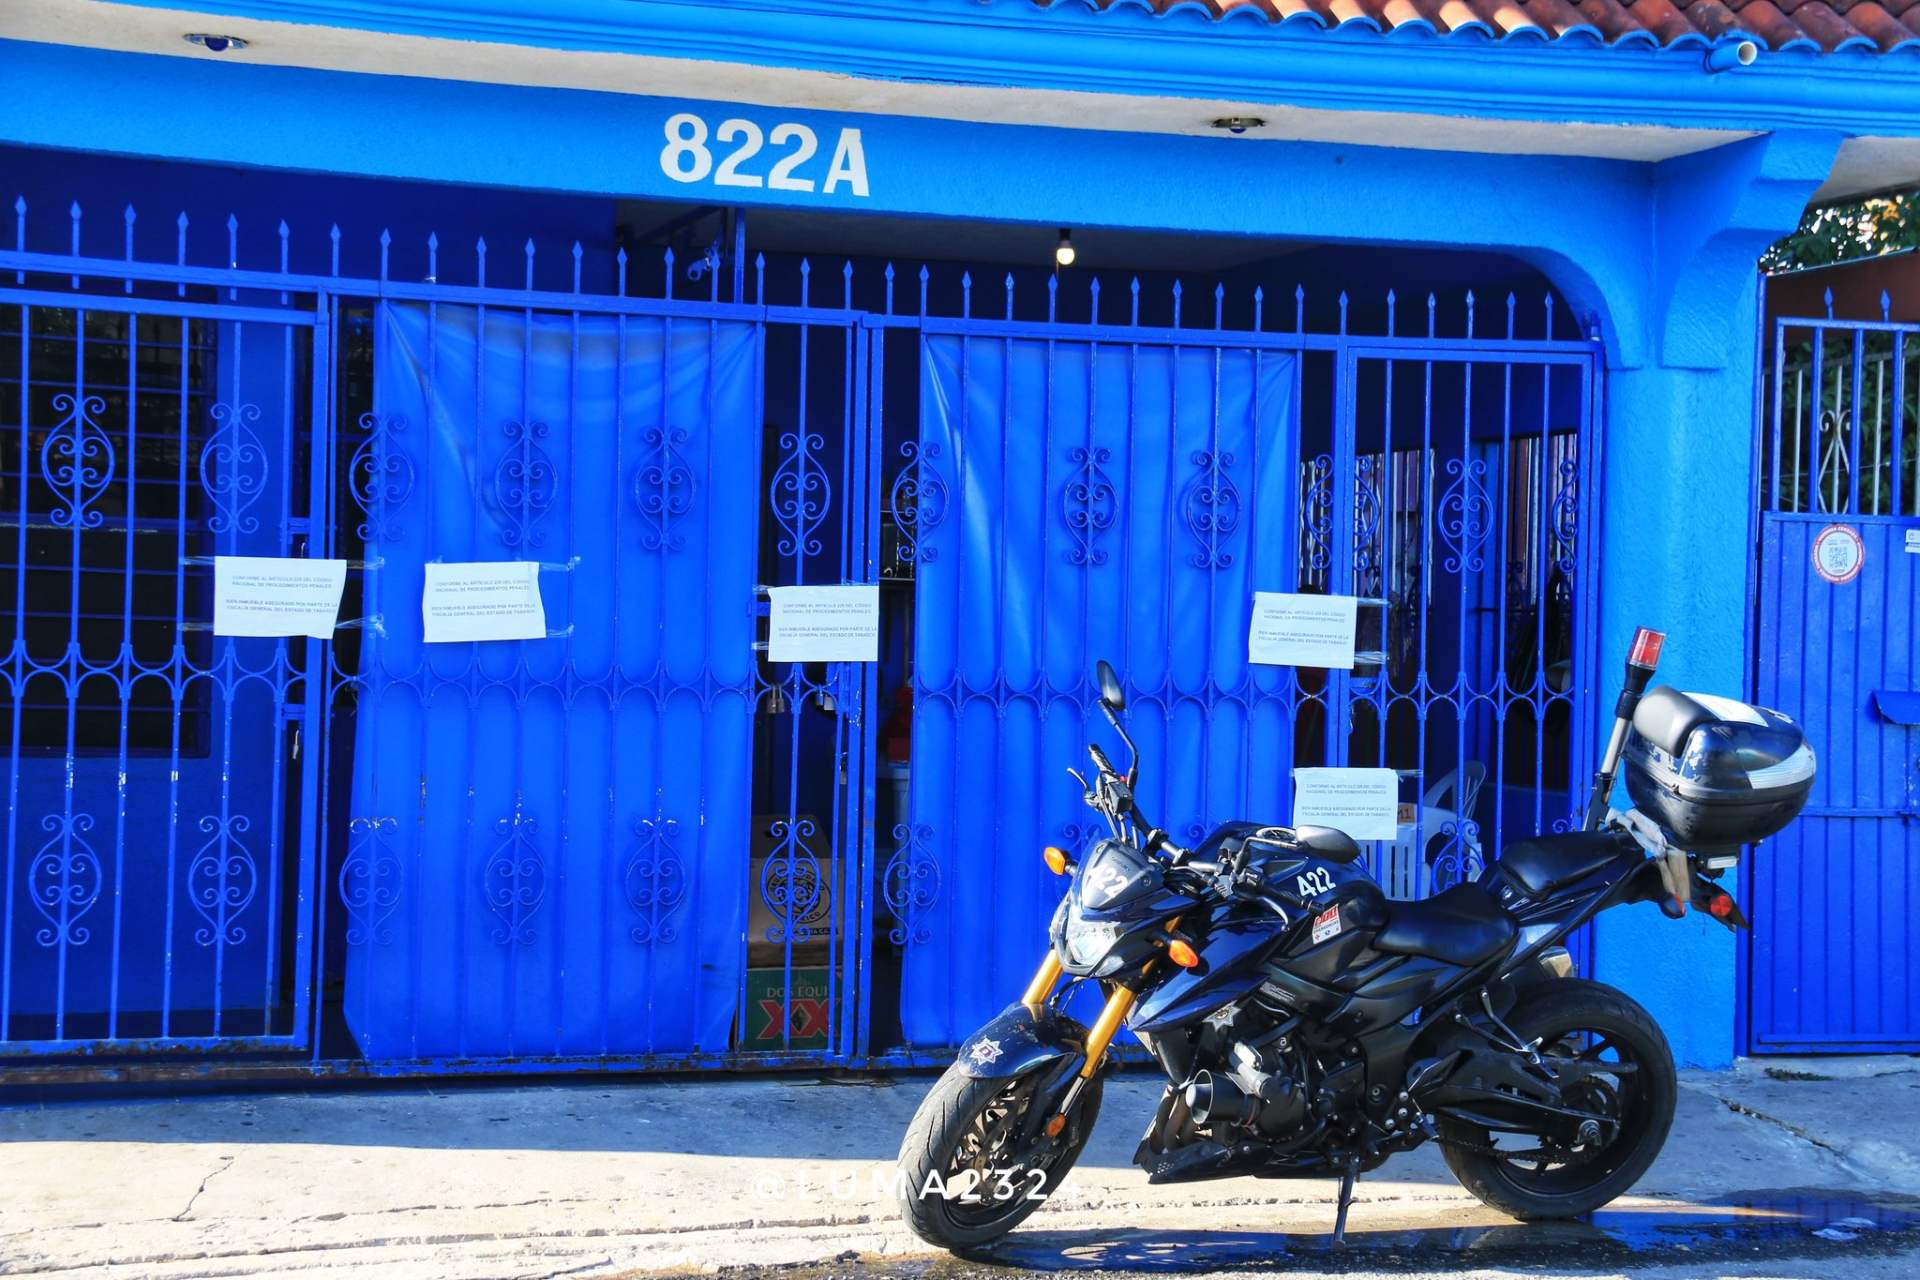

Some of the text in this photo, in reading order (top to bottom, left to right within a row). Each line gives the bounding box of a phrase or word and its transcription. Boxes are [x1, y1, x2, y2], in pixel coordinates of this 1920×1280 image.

[660, 113, 870, 197] 822A
[1297, 867, 1336, 896] 422
[767, 986, 830, 998] DO EQUI
